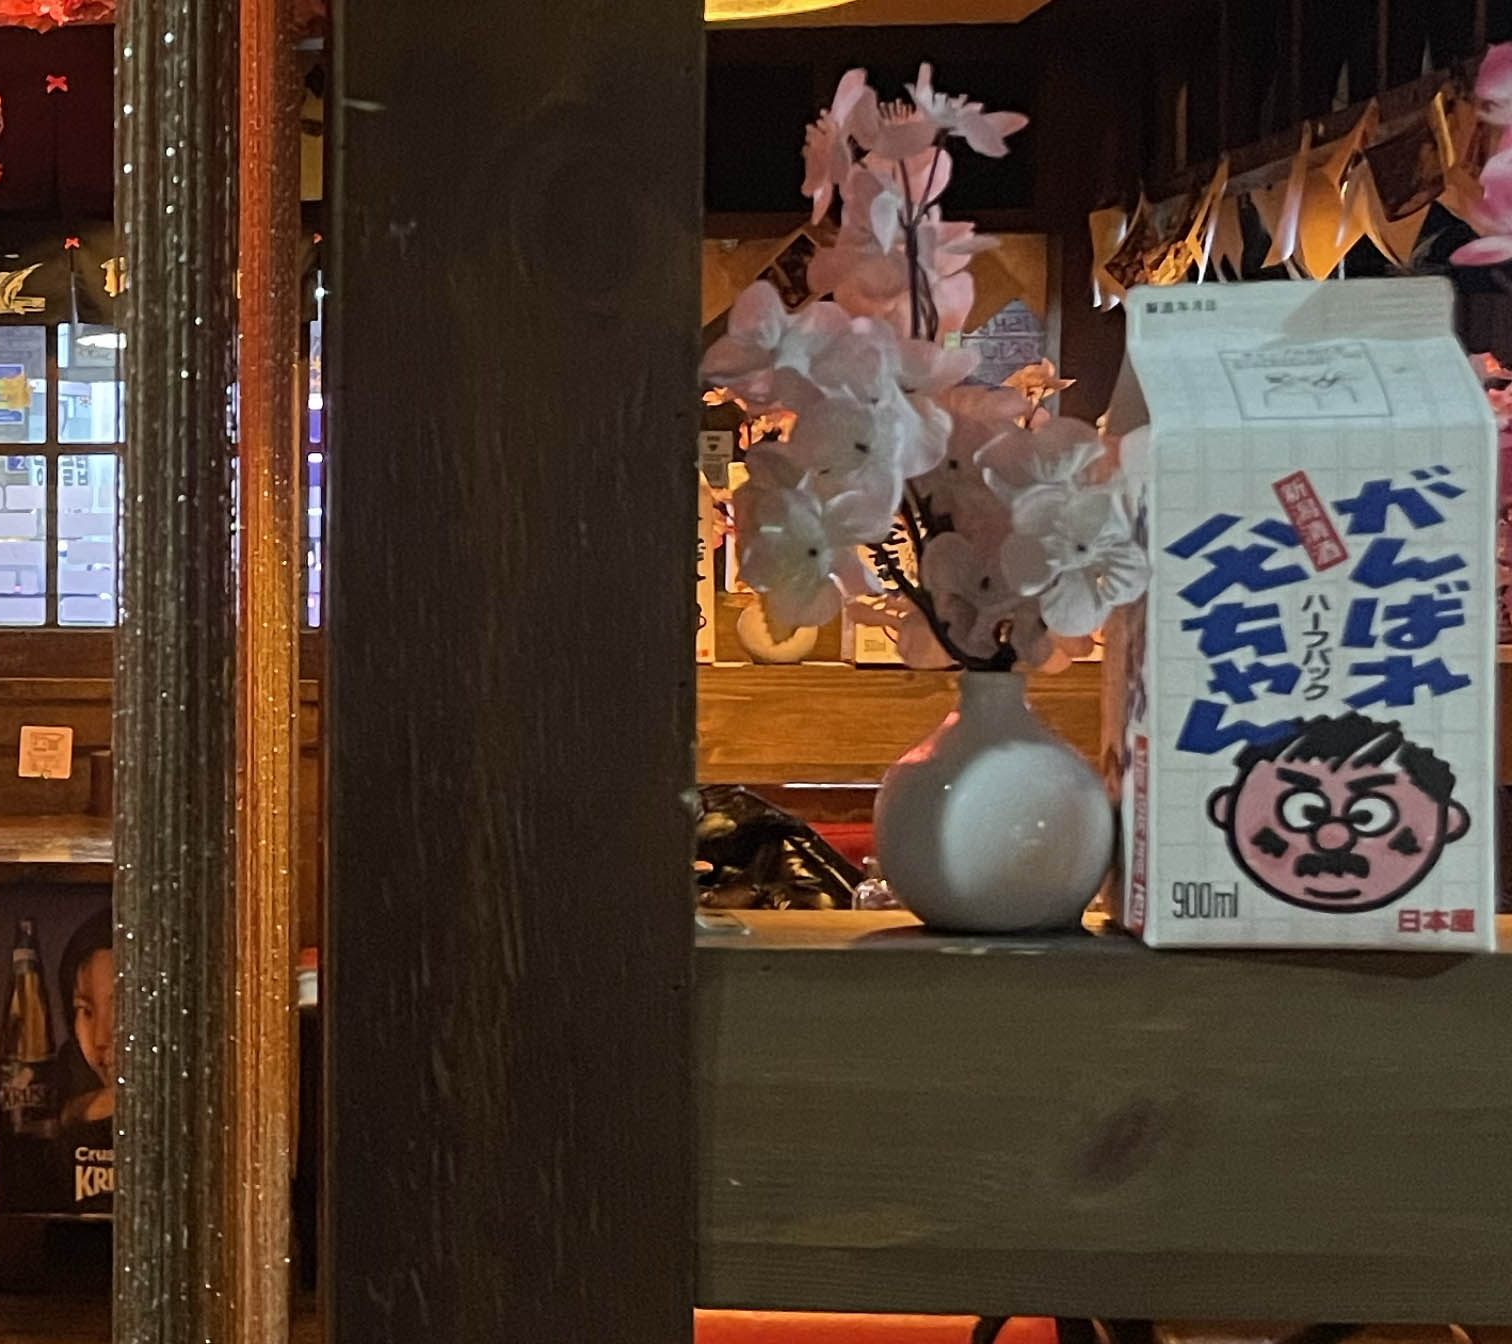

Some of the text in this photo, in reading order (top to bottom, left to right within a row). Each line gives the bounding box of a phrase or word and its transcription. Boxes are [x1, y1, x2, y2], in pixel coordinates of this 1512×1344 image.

[1162, 512, 1311, 755] 父ちゃん
[1331, 464, 1473, 709] がんばれ
[1171, 882, 1239, 919] 900ml
